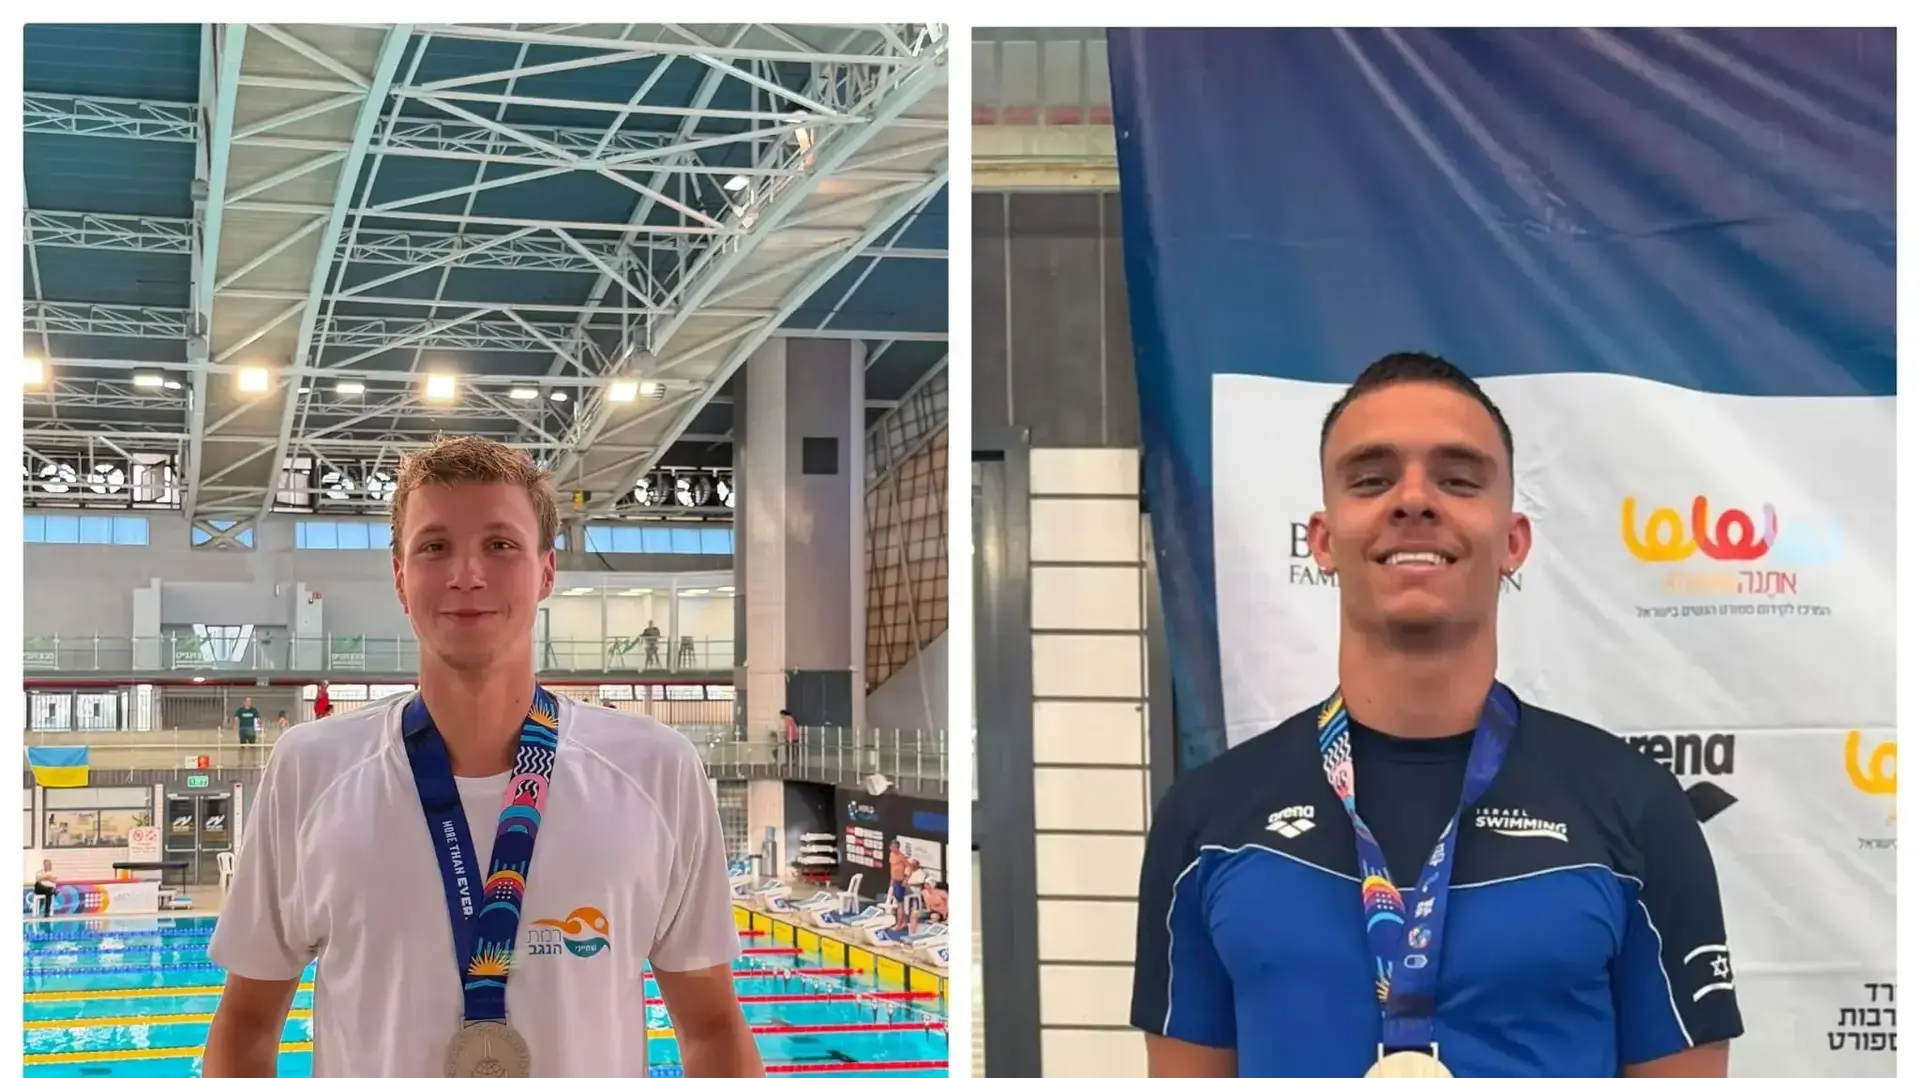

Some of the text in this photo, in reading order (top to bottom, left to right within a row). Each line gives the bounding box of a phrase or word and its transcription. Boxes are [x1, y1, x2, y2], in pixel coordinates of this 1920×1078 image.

[1289, 564, 1338, 588] FAM
[1622, 733, 1735, 776] rena
[1268, 805, 1315, 823] arena
[1476, 807, 1528, 817] ISRAEL
[442, 820, 458, 844] MORE
[1475, 815, 1567, 834] SWIMMING
[449, 843, 466, 875] THAN
[527, 928, 562, 943] רמת
[528, 943, 562, 956] הנגב
[1864, 982, 1897, 1003] רד
